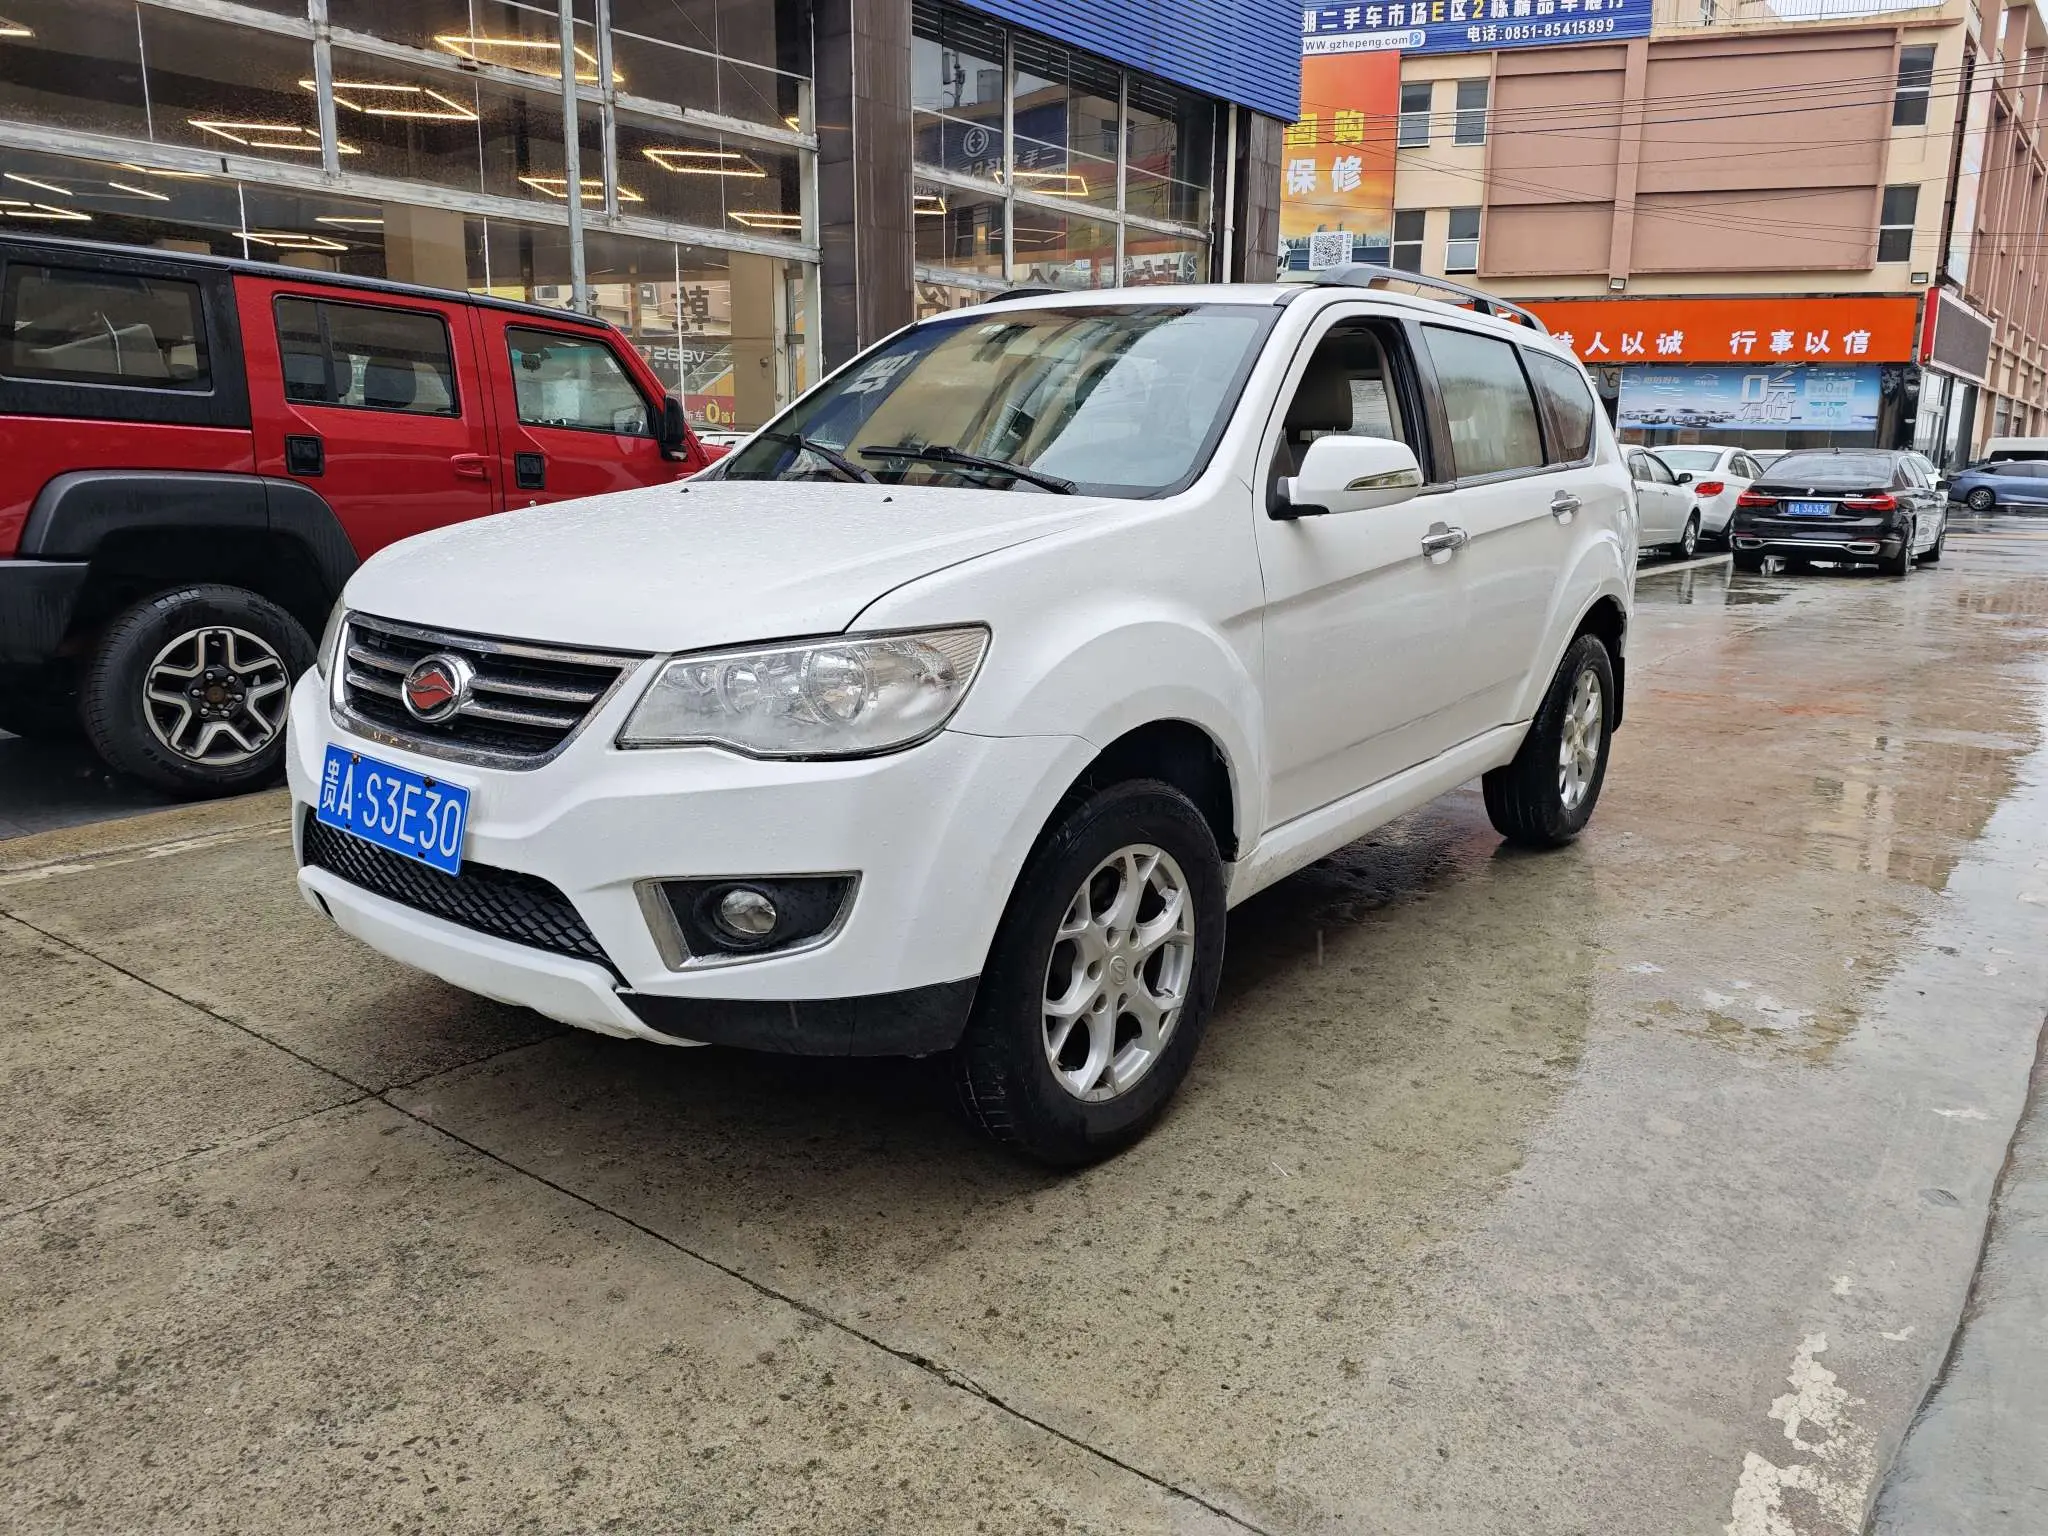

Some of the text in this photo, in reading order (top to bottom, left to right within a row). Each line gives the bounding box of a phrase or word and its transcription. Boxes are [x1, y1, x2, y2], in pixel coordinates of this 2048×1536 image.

[1286, 155, 1363, 195] 保修
[1729, 329, 1871, 355] 行事以信
